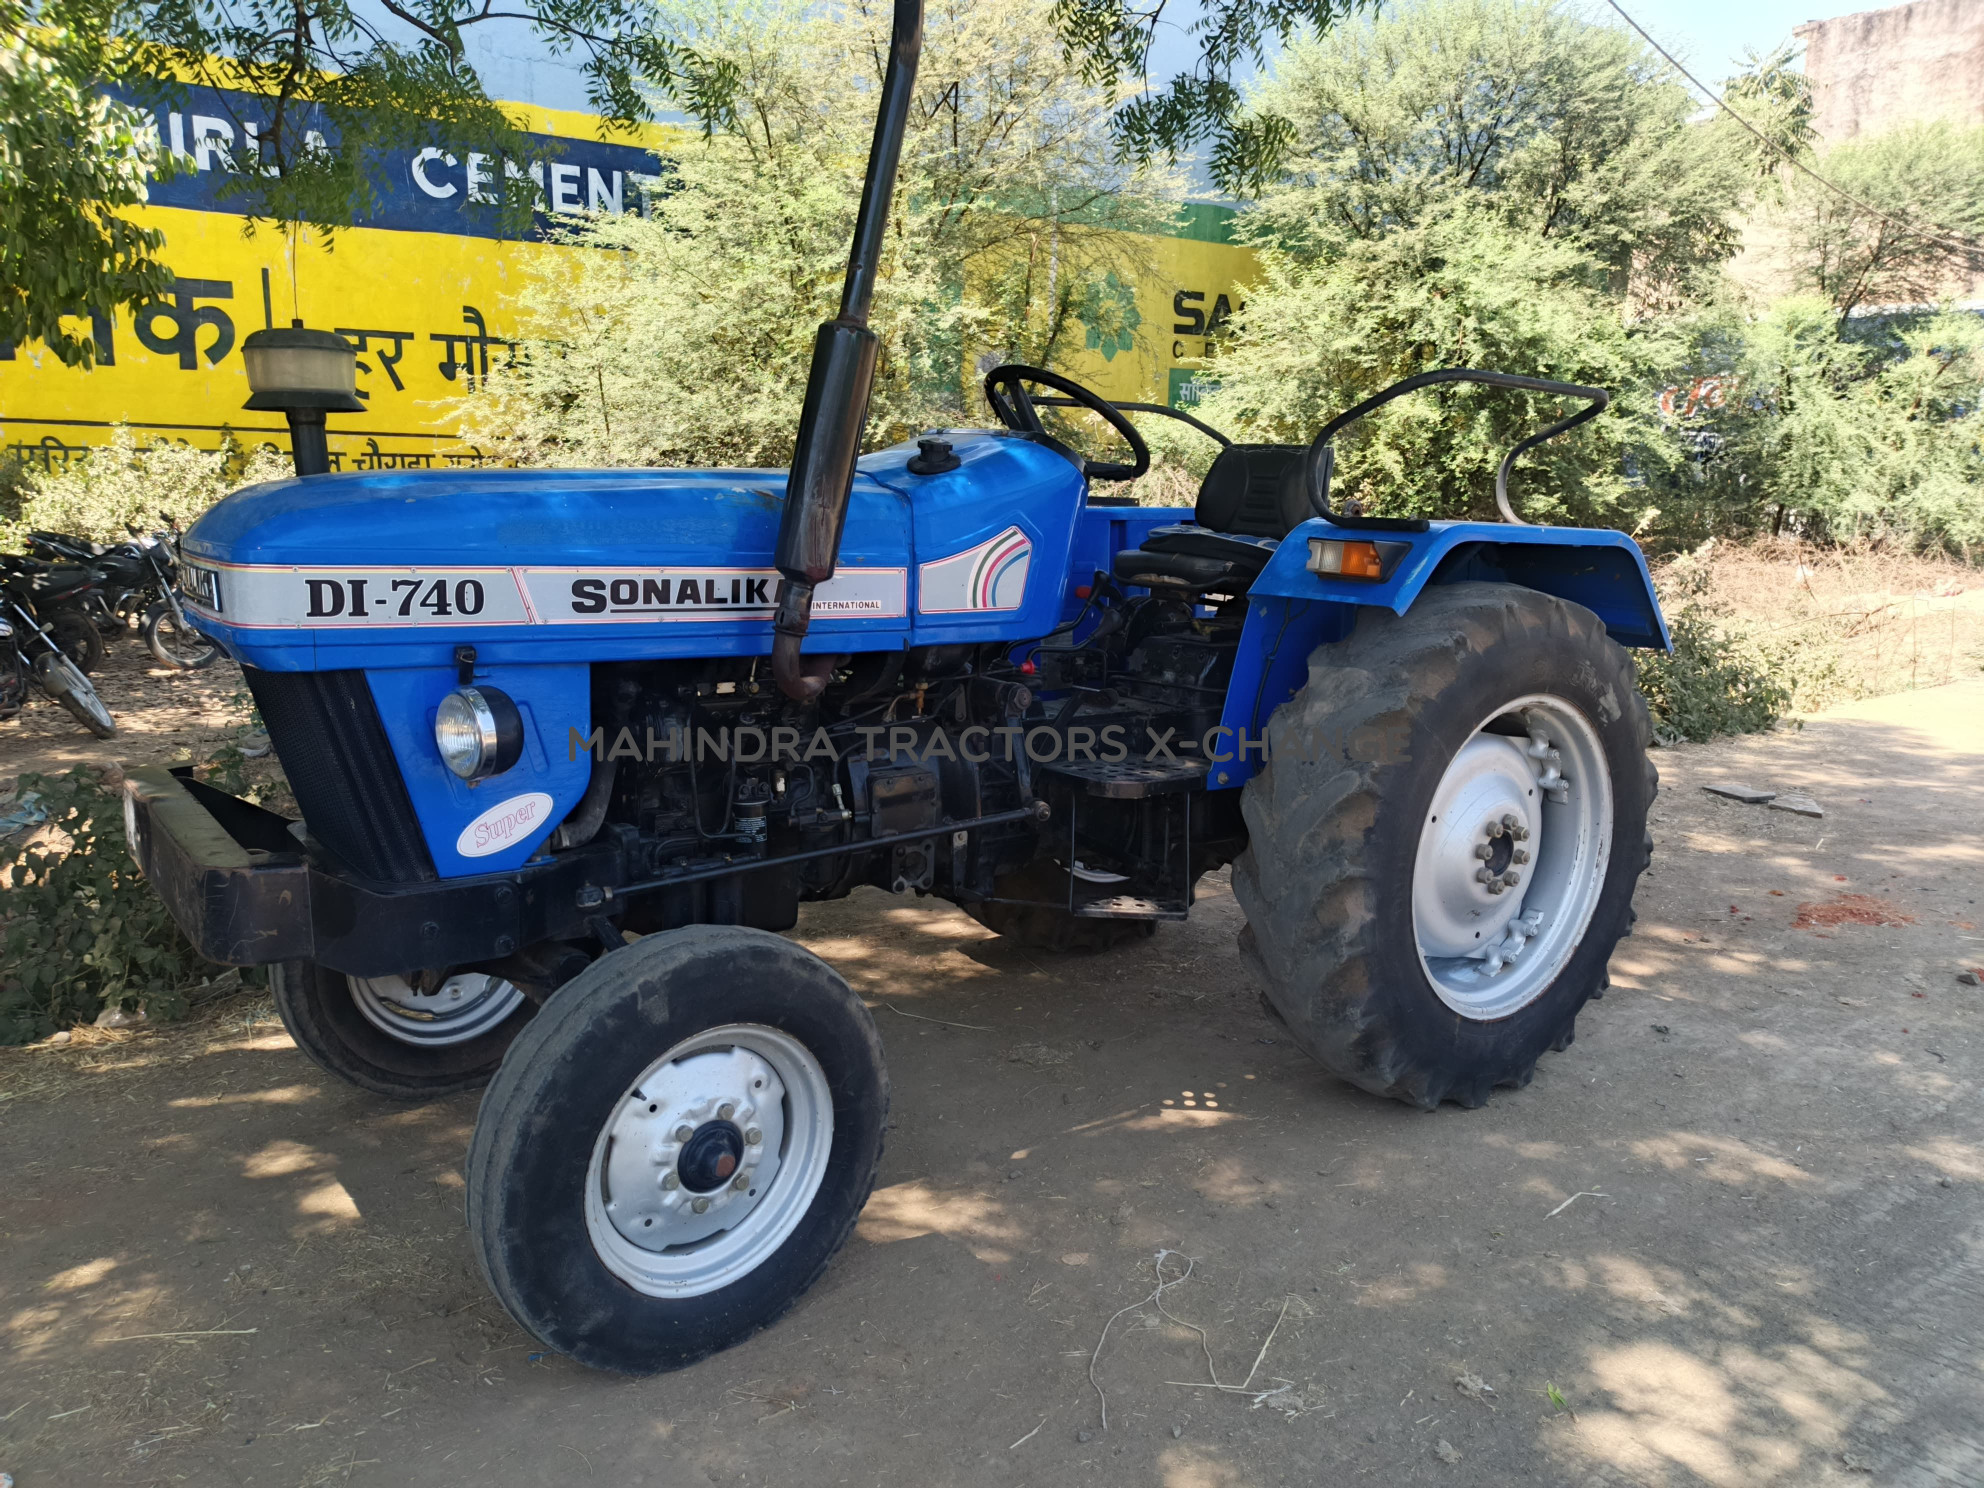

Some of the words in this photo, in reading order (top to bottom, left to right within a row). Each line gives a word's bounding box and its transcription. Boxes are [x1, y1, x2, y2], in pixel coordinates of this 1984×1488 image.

[304, 579, 485, 617] DI-740
[571, 578, 786, 614] SONALIK
[812, 601, 880, 610] INTERNATIONAL
[474, 801, 536, 848] Super
